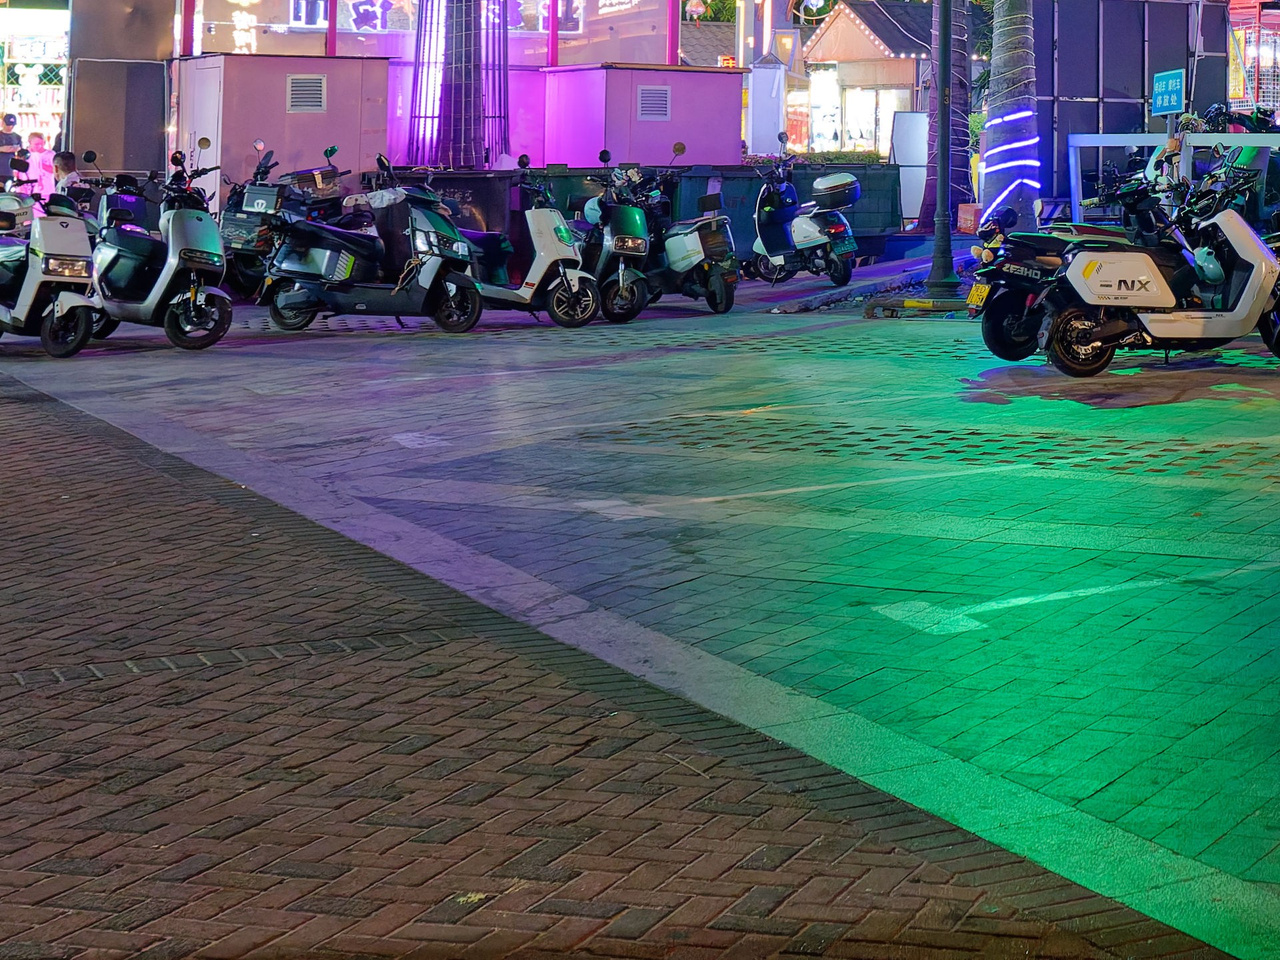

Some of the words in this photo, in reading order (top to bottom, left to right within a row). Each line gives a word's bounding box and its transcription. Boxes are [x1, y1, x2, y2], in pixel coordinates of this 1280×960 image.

[1156, 93, 1178, 108] 停放处
[1117, 279, 1151, 292] NX
